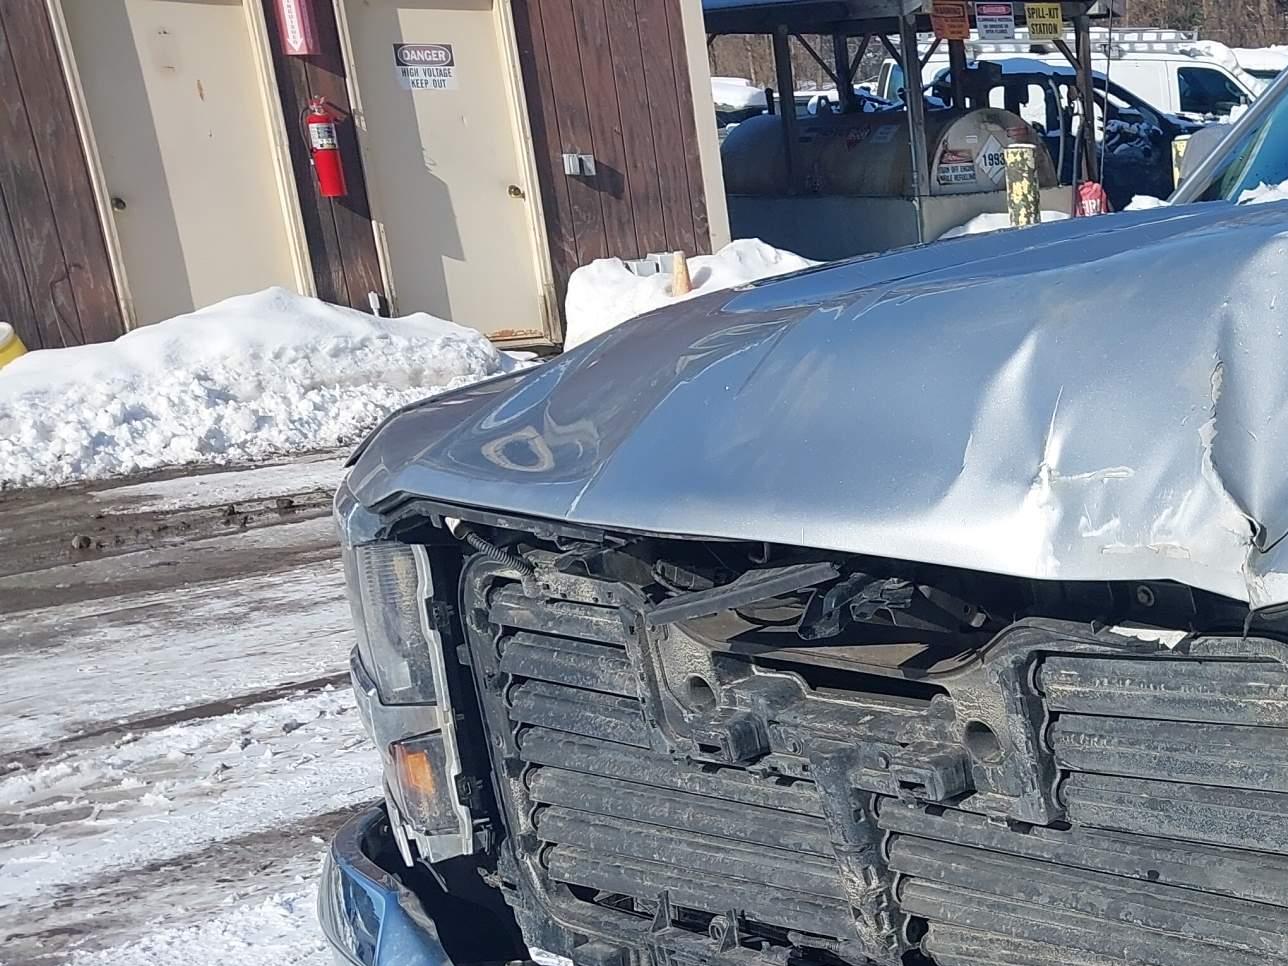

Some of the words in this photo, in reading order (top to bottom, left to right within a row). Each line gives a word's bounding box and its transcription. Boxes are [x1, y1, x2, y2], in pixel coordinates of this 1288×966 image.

[1027, 7, 1059, 19] SPILL-KIT
[1031, 23, 1058, 34] STATION
[402, 50, 446, 61] DANGER
[401, 67, 420, 77] HIGH
[423, 67, 453, 77] VOLTAGE
[411, 79, 429, 88] KEEP
[432, 79, 447, 88] OUT
[982, 152, 1006, 167] 1993
